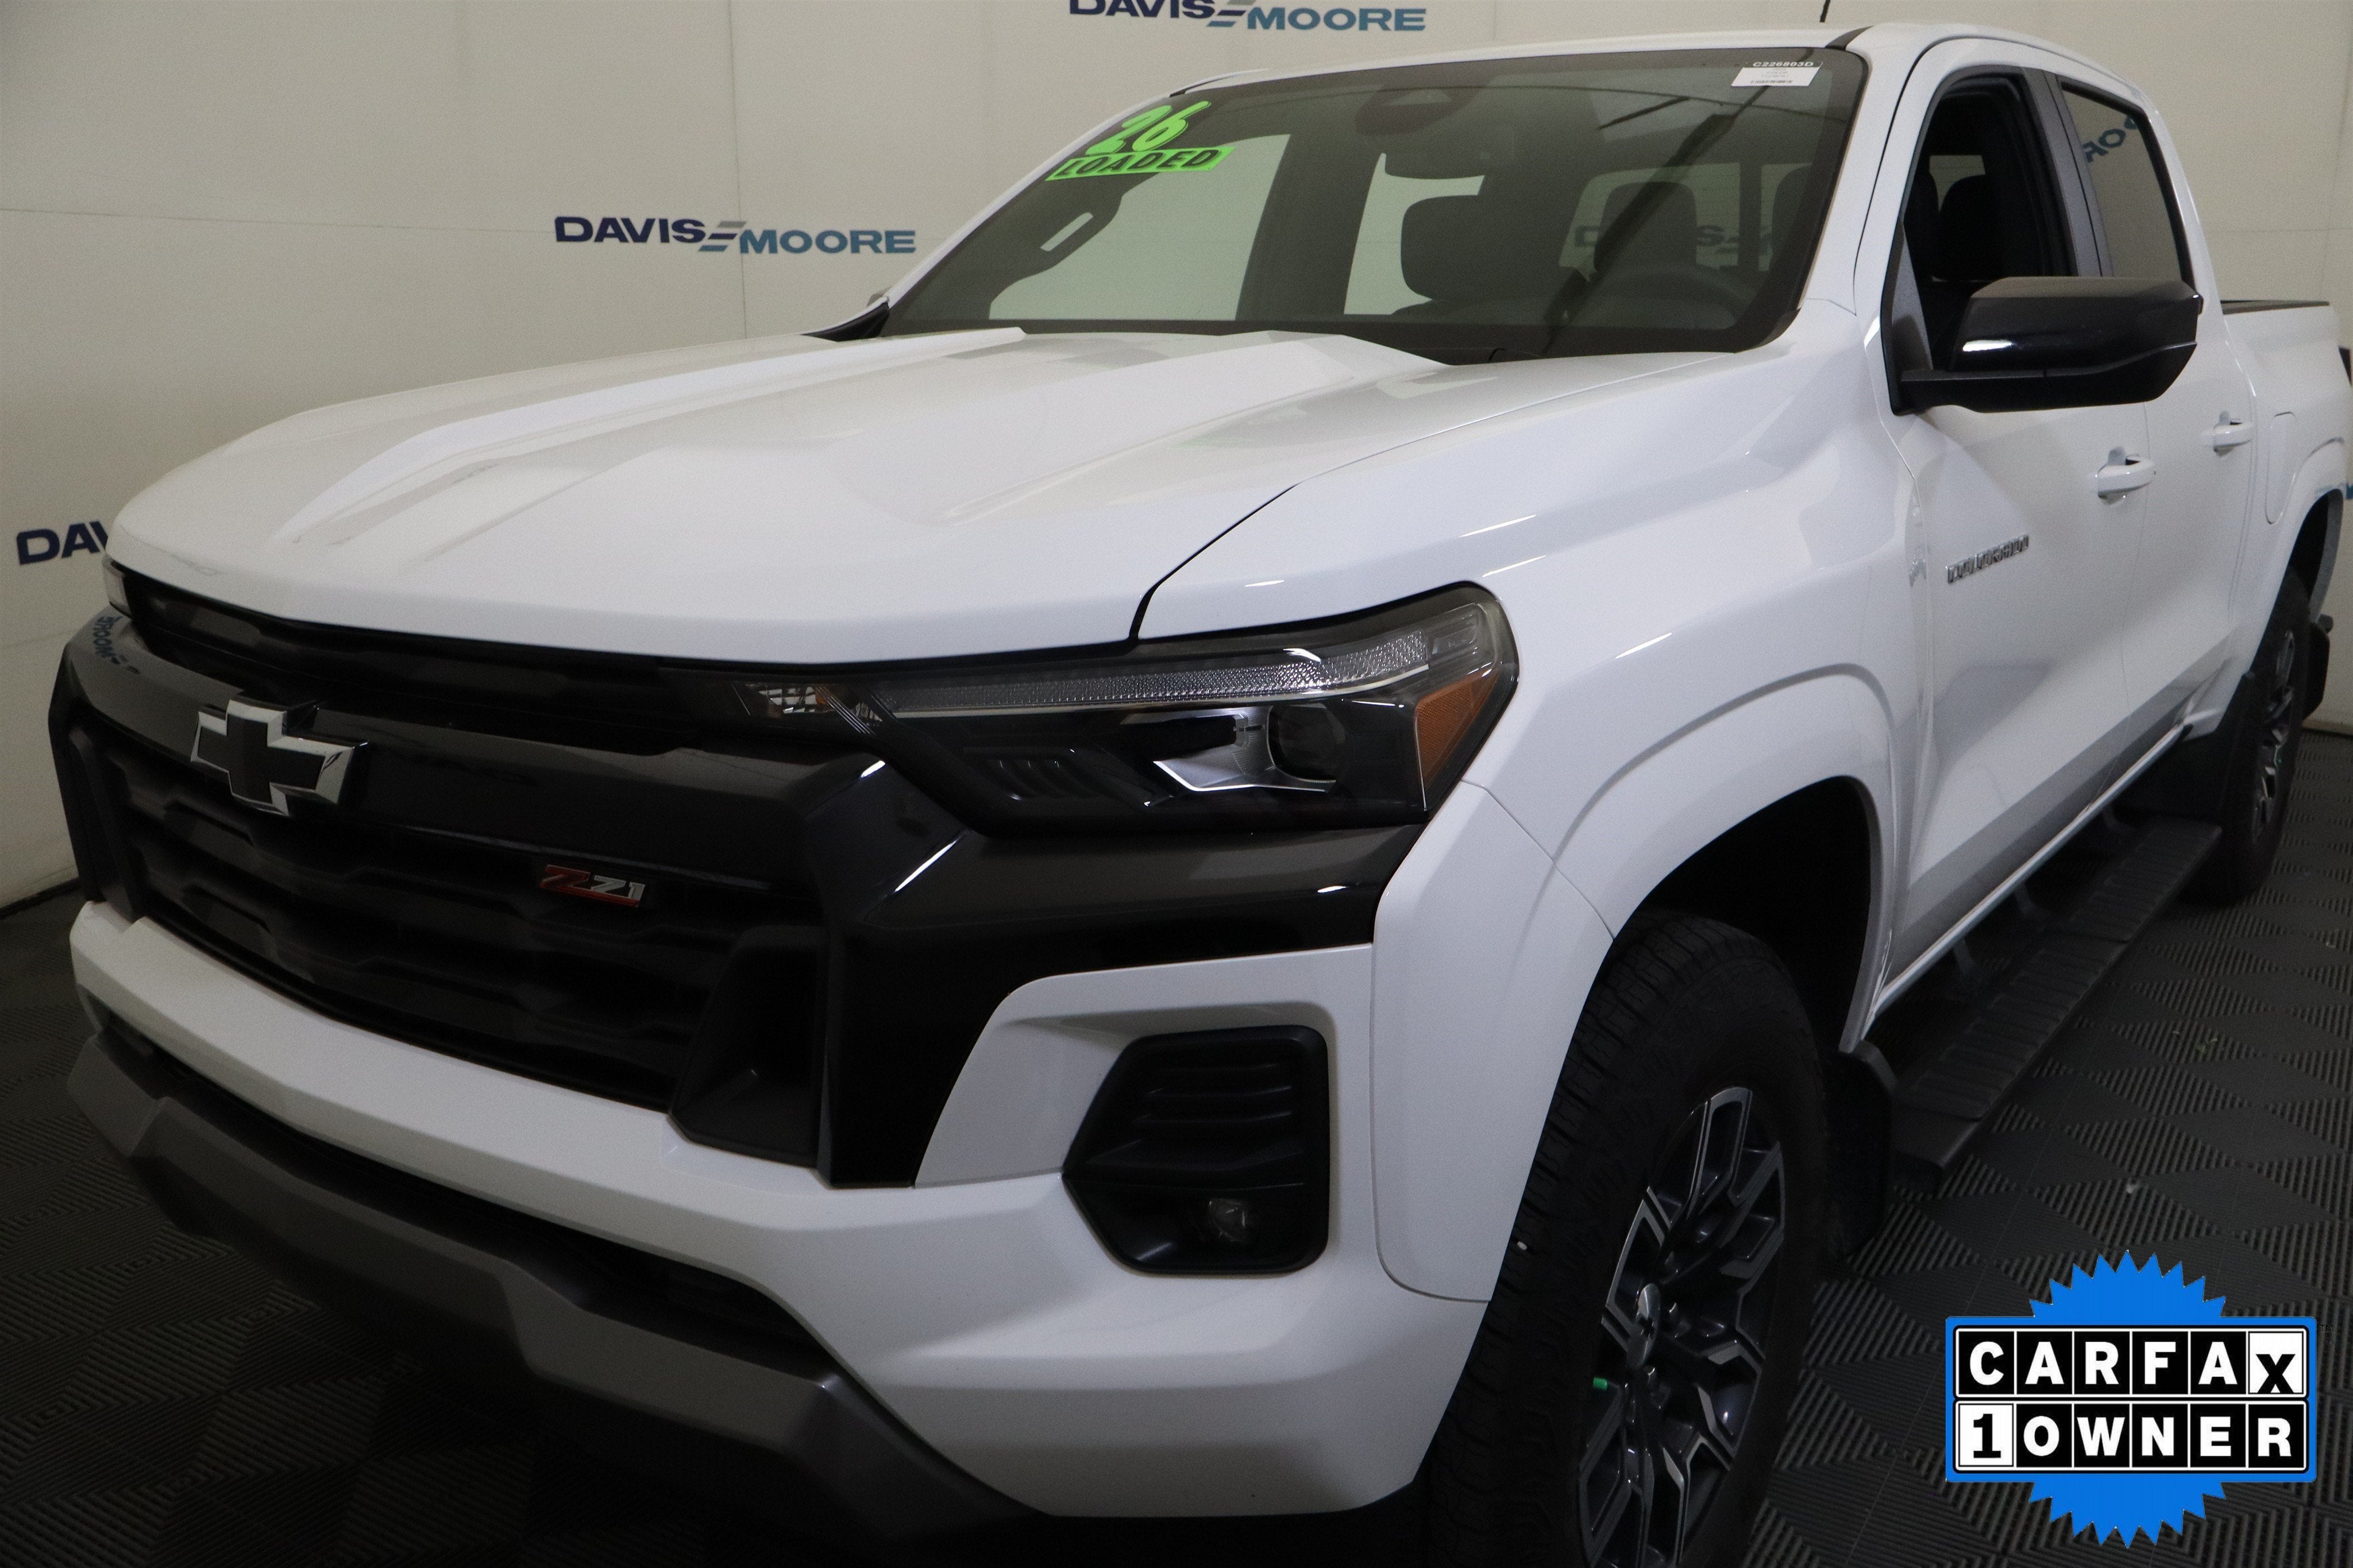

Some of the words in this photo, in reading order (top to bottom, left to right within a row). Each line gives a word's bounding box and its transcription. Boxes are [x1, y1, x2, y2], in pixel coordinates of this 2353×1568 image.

[1247, 7, 1426, 31] MOORE
[1085, 101, 1212, 156] 26
[1054, 149, 1221, 178] LOADED
[554, 217, 705, 243] DAVIS
[739, 230, 916, 253] MOORE
[540, 864, 646, 907] Z71
